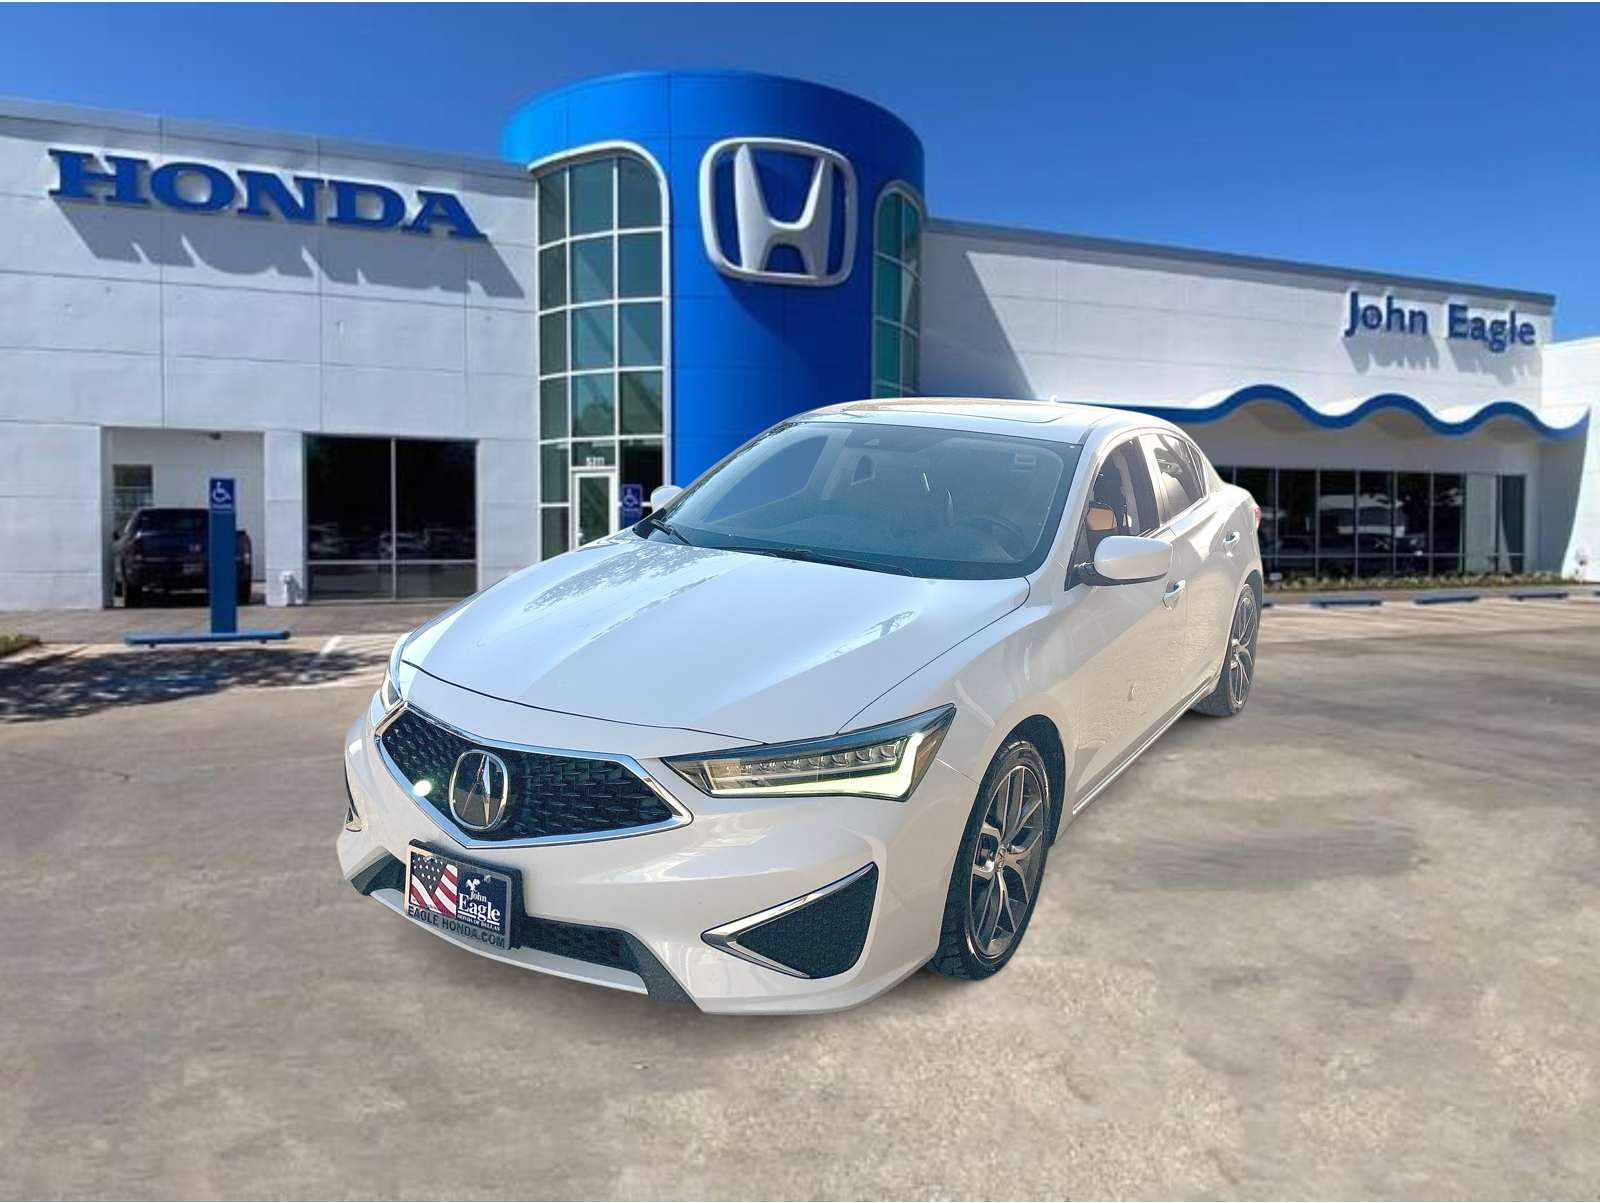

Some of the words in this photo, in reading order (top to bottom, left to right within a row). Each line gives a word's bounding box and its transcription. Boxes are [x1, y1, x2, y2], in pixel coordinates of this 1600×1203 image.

[48, 148, 488, 241] HONDA
[1344, 290, 1428, 338] John
[1448, 303, 1536, 353] Eagle
[457, 892, 501, 922] Eagle
[470, 891, 487, 903] John
[408, 905, 438, 925] EAGLE
[443, 920, 505, 948] HONDA.COM
